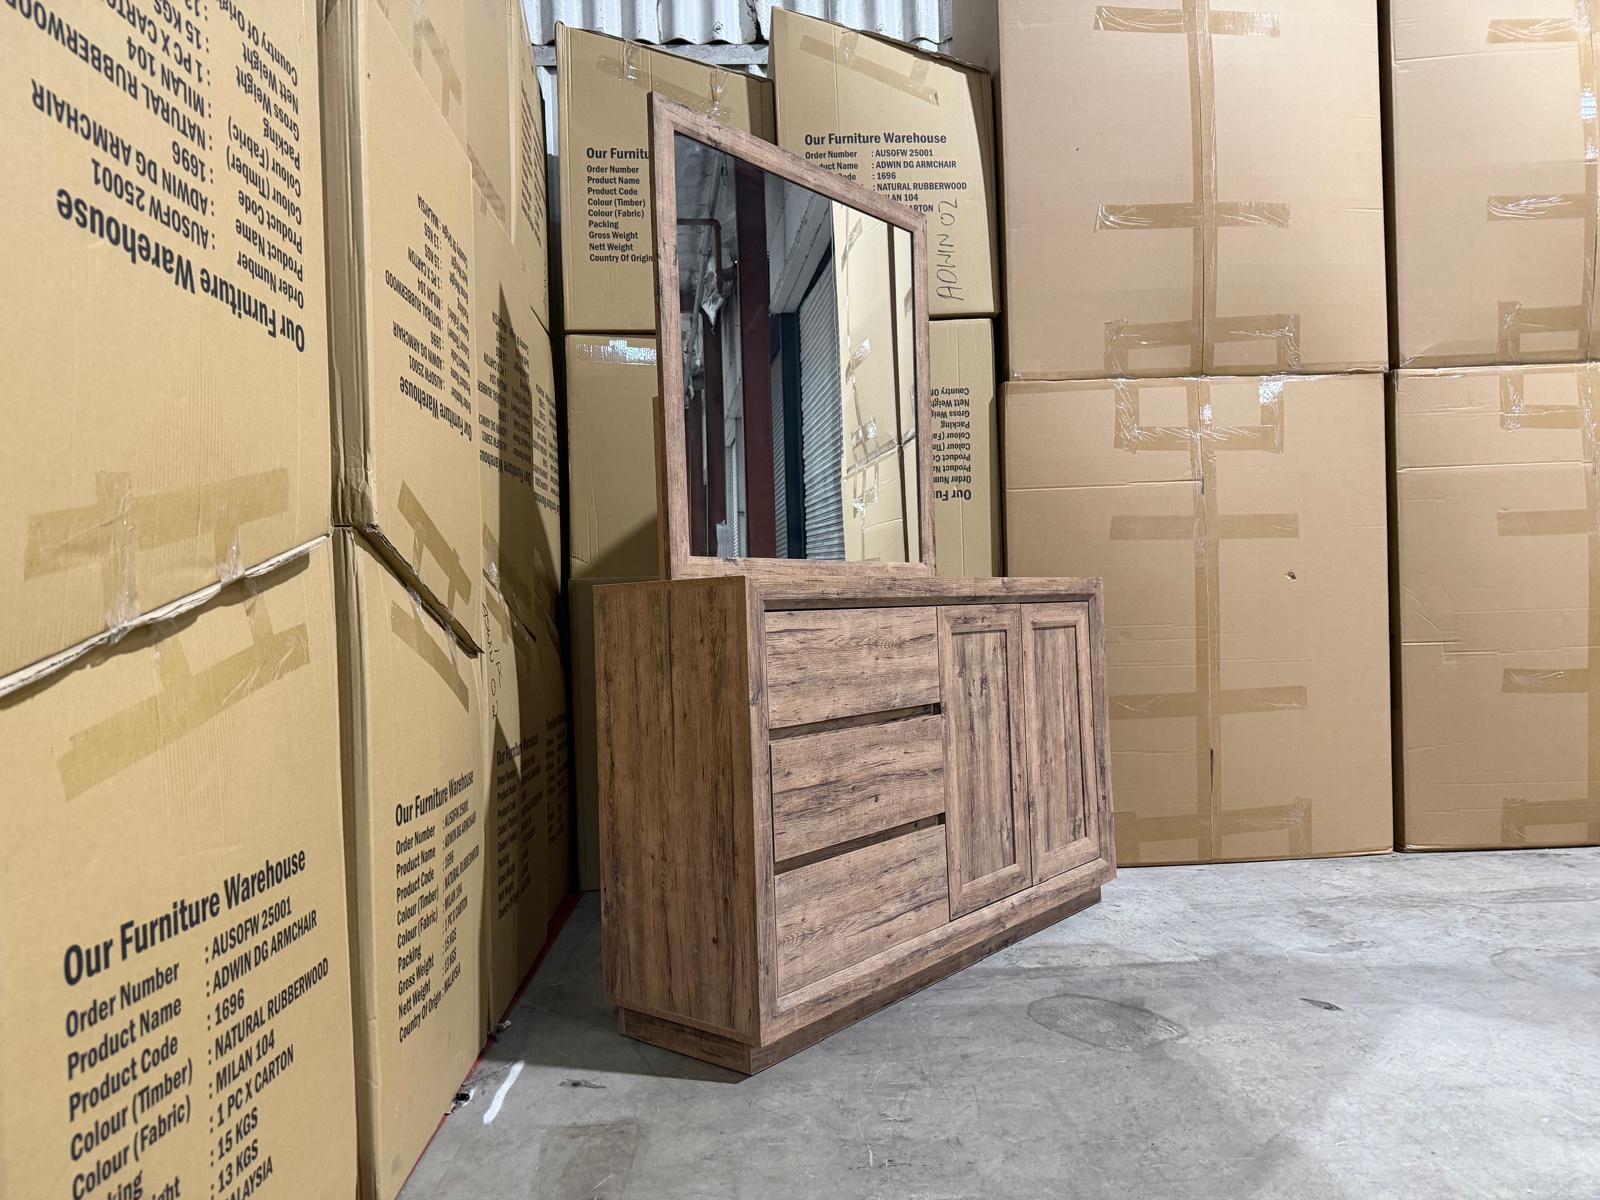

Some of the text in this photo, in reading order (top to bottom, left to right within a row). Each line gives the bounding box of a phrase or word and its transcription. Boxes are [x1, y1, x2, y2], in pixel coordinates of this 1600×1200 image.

[185, 19, 201, 49] 15
[247, 20, 297, 87] Country Of
[235, 65, 272, 117] Weight
[241, 42, 298, 115] Nett Weight
[126, 36, 301, 198] Colour (Fabric) MILAN 104
[160, 29, 300, 171] Packing 1 PC X
[273, 103, 299, 142] Gross
[805, 133, 947, 145] Our Furniture Warehouse
[141, 83, 302, 226] Colour (Timber) NATURAL
[587, 148, 649, 159] Our Furnitu
[587, 165, 639, 173] Order Number
[805, 149, 933, 160] Order Number AUSOFW 25001
[837, 162, 858, 170] Name
[31, 79, 303, 282] Product Name ADWIN DG ARMCHAIR
[587, 176, 616, 184] Product
[587, 187, 616, 195] Product
[877, 172, 896, 180] 1696
[877, 182, 967, 191] NATURAL RUBBERWOOD
[172, 140, 302, 254] Product Code 1696
[588, 198, 645, 207] Colour (Timber)
[588, 209, 644, 219] Colour (Fabric)
[91, 158, 304, 309] Order Number AUSOFW 25001
[589, 220, 619, 229] Packing
[589, 231, 638, 241] Gross Weight
[589, 243, 633, 252] Nett Weight
[590, 254, 619, 263] Country
[56, 188, 305, 352] Our Furniture Warehouse
[385, 269, 421, 313] RUBBERWOOD
[392, 320, 420, 354] ARMCHAIR
[399, 375, 439, 420] Warehouse
[941, 387, 969, 395] Country
[439, 402, 463, 436] Furniture
[942, 464, 970, 472] Product
[951, 475, 971, 483] Order
[952, 490, 971, 500] Our
[395, 770, 474, 826] Our Furniture Warehouse
[395, 825, 435, 856] Order Number
[396, 846, 435, 879] Product Name
[396, 867, 434, 903] Product Code
[63, 850, 305, 986] Our Furniture Warehouse
[396, 884, 439, 926] Colour (Timber)
[397, 906, 438, 949] Colour (Fabric)
[65, 896, 292, 1037] Order Number AUSOFW 25001
[397, 942, 421, 973] Packing
[398, 952, 434, 996] Gross Weight
[67, 909, 317, 1080] Product Name ADWIN DG ARMCHAIR
[398, 978, 431, 1019] Nett Weight
[399, 1012, 421, 1043] Country
[69, 988, 244, 1122] Product Code 1696
[70, 957, 328, 1161] Colour (Timber) NATURAL RUBBERWOOD
[217, 1044, 293, 1127] 1 PC X CARTON
[72, 1145, 129, 1200] Colour
[133, 1094, 190, 1162] (Fabric)
[216, 1046, 252, 1093] MILAN
[255, 1028, 275, 1061] 104
[218, 1106, 258, 1160] 15 KGS
[218, 1162, 233, 1193] 13
[236, 1138, 258, 1176] KGS
